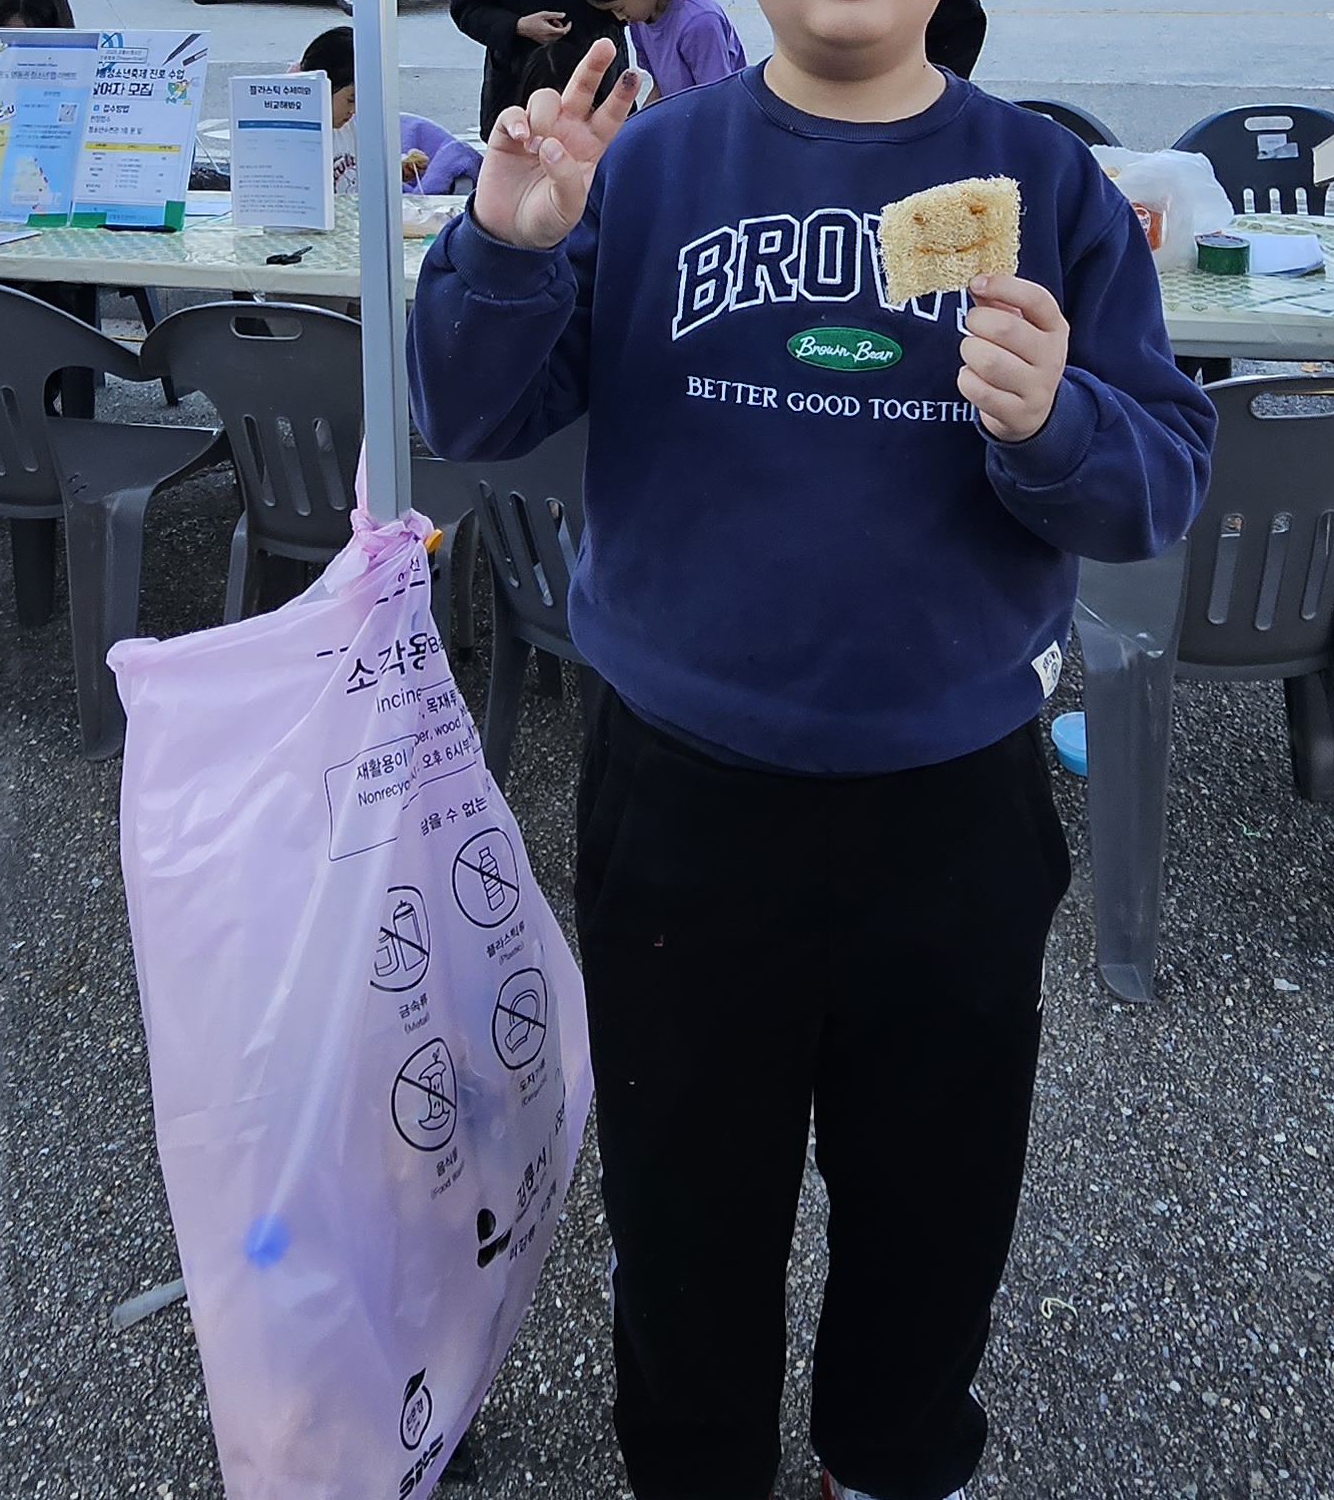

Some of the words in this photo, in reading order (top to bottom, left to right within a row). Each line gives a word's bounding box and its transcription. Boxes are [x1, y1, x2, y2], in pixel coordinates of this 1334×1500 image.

[128, 82, 154, 97] 모집
[249, 85, 281, 96] 플라스틱
[672, 208, 974, 343] BRO
[796, 336, 850, 359] Brown
[852, 341, 895, 363] Bear
[686, 375, 779, 409] BETTER
[787, 393, 861, 418] GOOD
[868, 397, 977, 422] TOGETH
[346, 632, 428, 695] 소각용
[356, 748, 408, 781] 재활용이
[422, 749, 443, 769] 오후
[446, 807, 458, 823] 수
